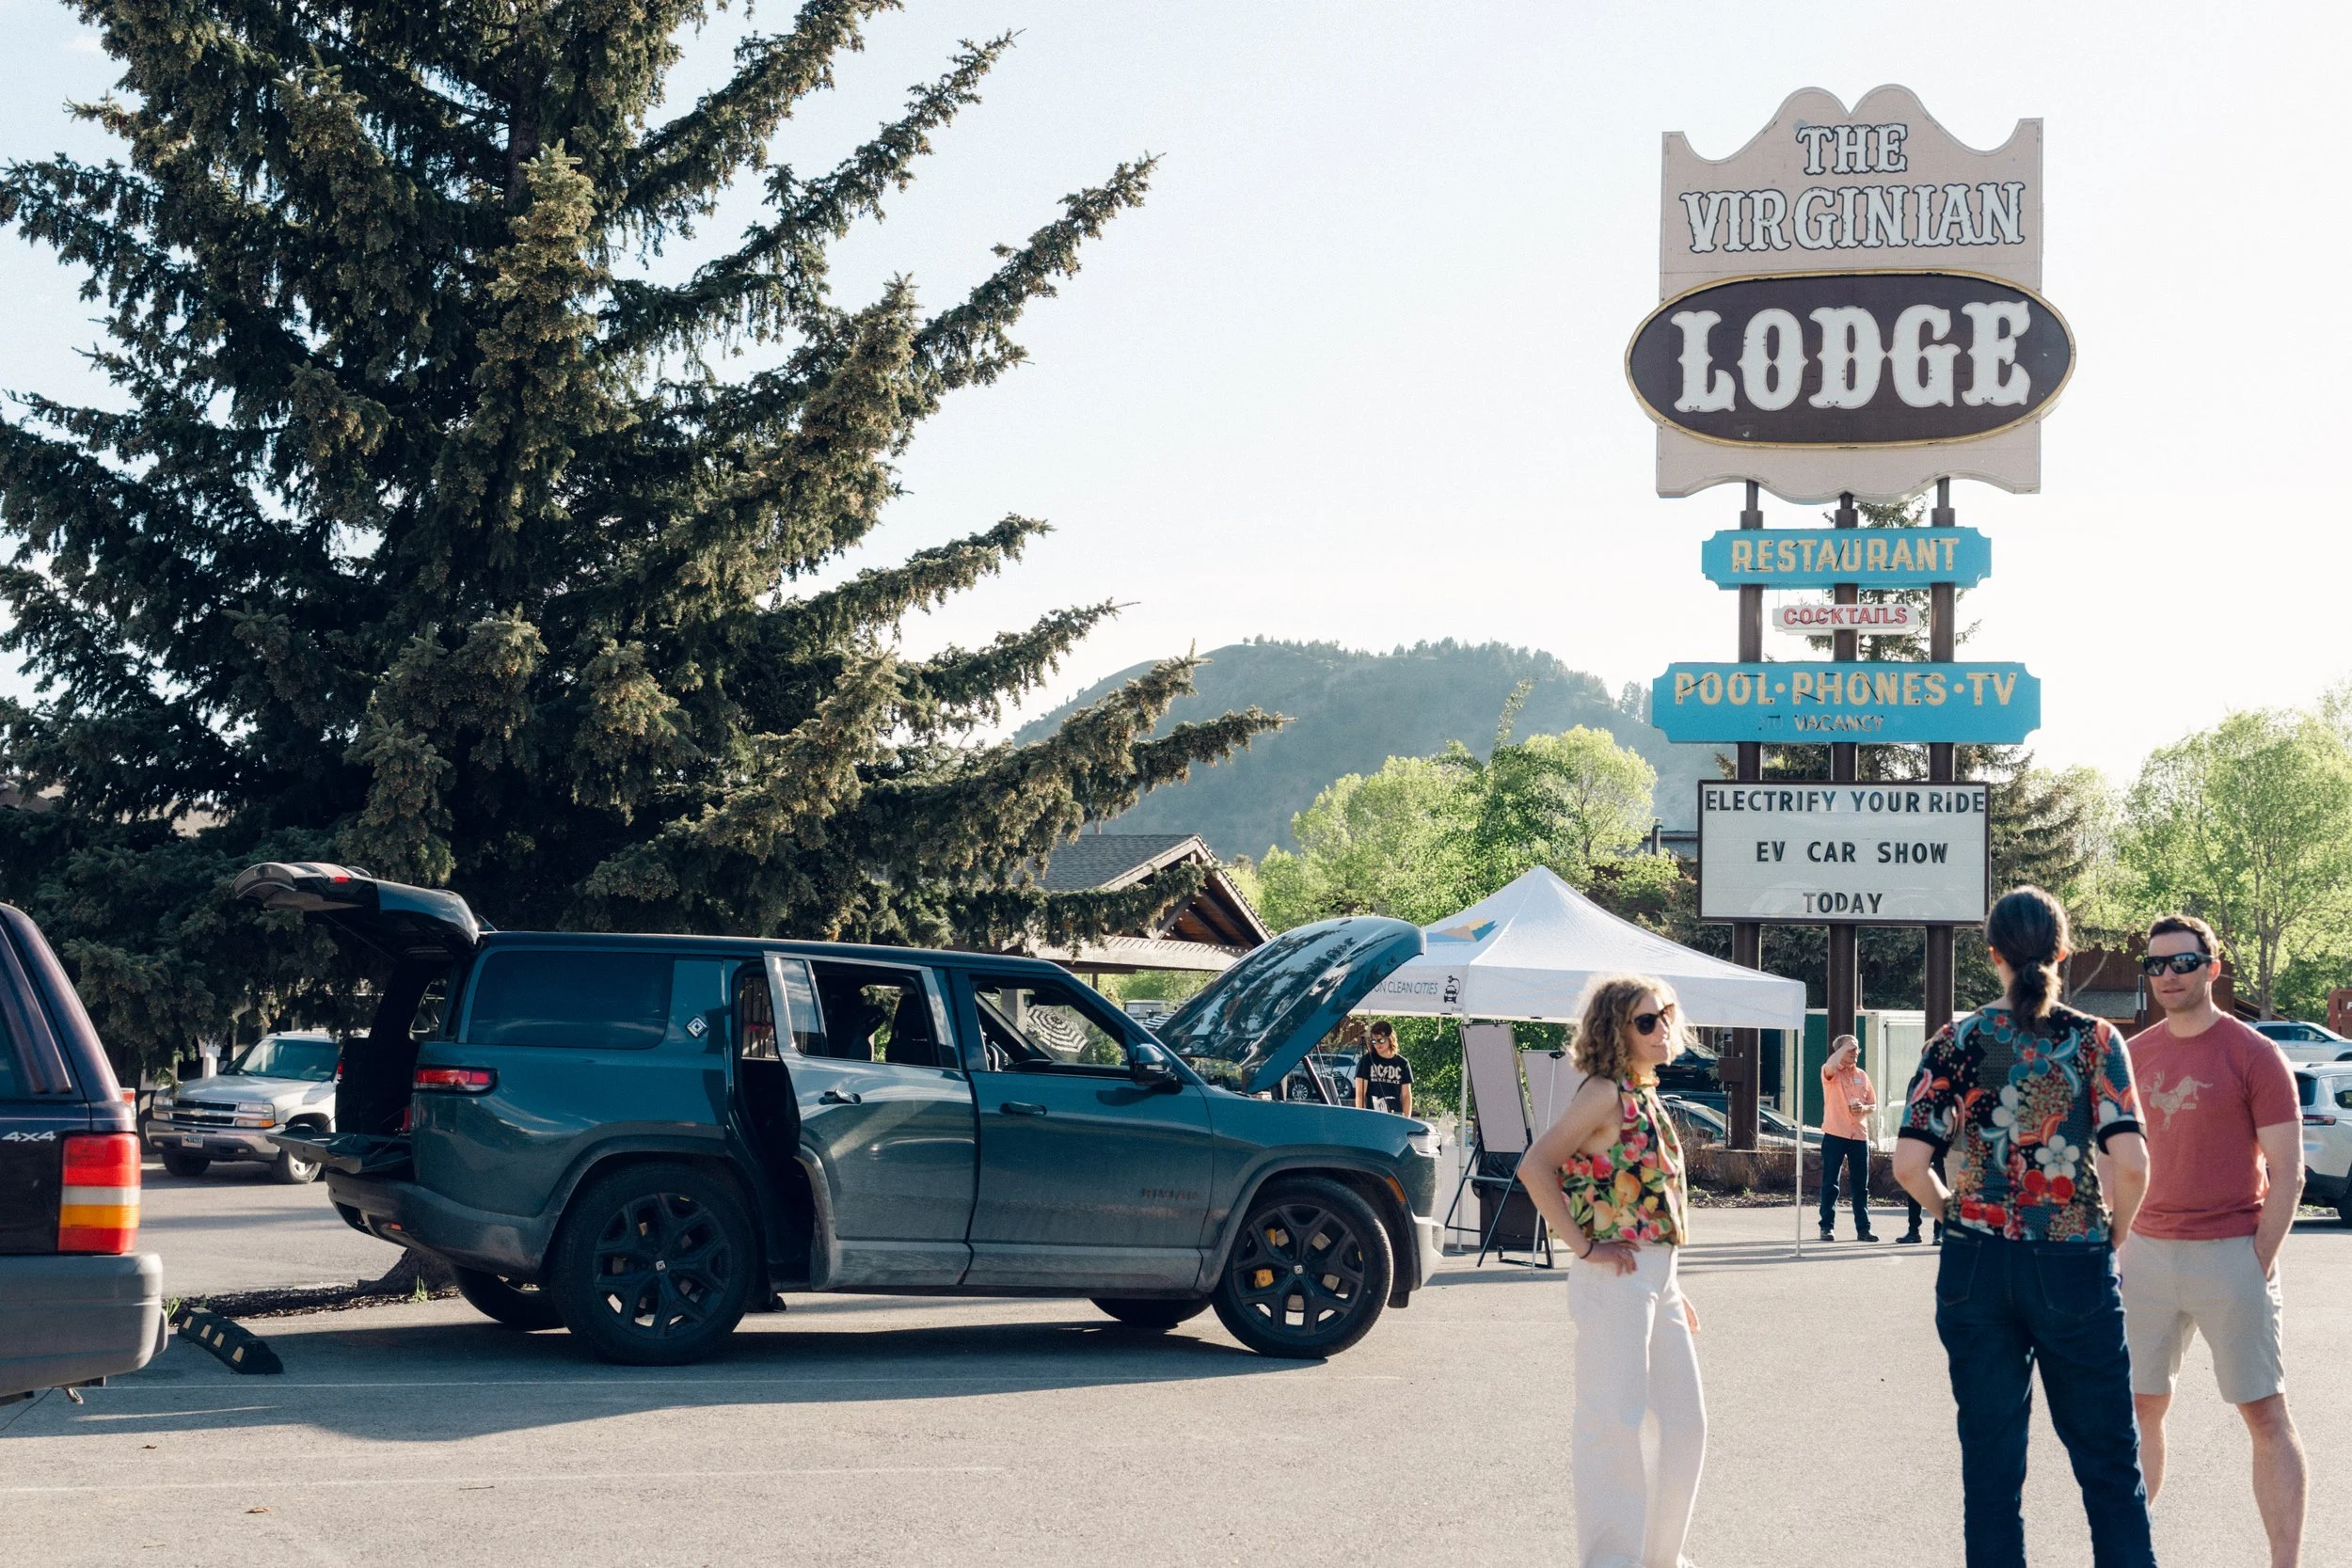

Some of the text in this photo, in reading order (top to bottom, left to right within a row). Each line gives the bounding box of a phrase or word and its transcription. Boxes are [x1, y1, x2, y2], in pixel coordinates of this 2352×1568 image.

[1795, 123, 1908, 176] THE
[1679, 182, 2026, 254] VIRGINIAN
[1671, 300, 2031, 412] LODGE
[1732, 537, 1960, 573] RESTAURANT
[1783, 607, 1908, 626] COCKTAILS
[1675, 672, 2017, 705] POOL PHONES TV
[1794, 714, 1884, 732] VACANCY
[1705, 790, 1985, 814] ELECTRIFY YOUR RIDE
[1756, 841, 1948, 863] EV CAR SHOW
[1803, 892, 1883, 914] TODAY
[1388, 981, 1411, 993] CLEAN
[1414, 982, 1438, 994] CITIES
